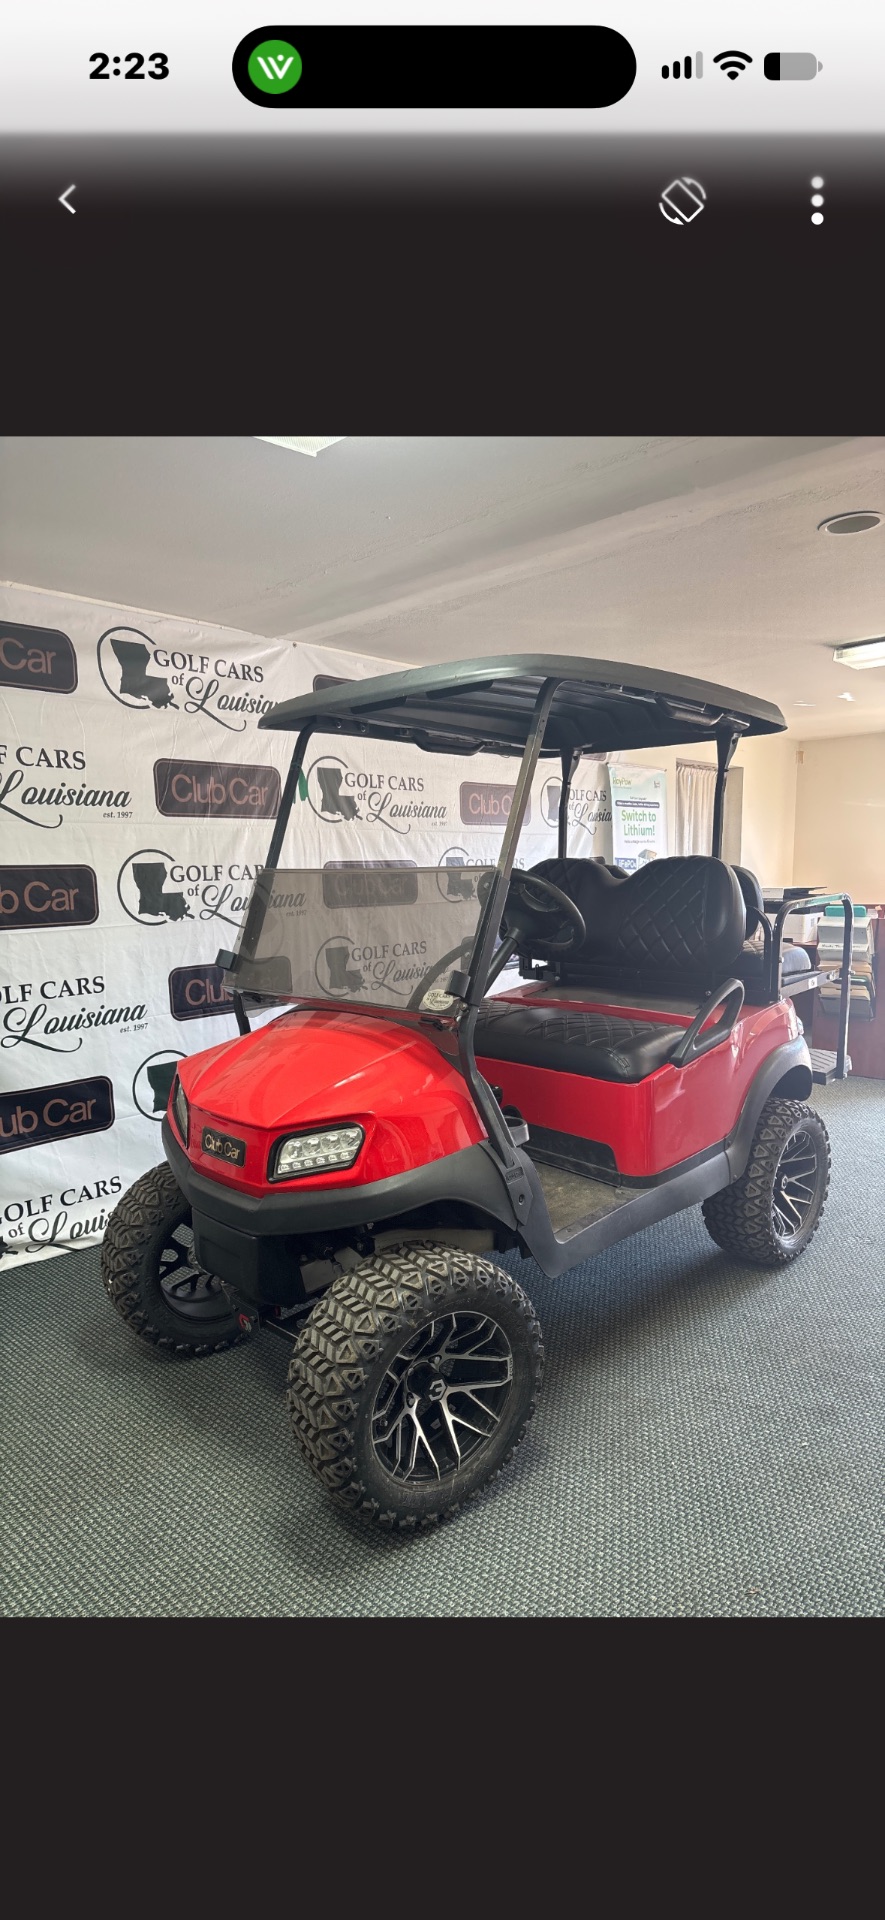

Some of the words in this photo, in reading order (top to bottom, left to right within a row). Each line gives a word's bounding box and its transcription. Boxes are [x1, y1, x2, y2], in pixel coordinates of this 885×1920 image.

[153, 650, 210, 674] GOLF
[214, 659, 264, 683] CARS
[171, 673, 185, 686] of
[184, 676, 279, 732] Louisia
[15, 746, 87, 771] CARS
[171, 773, 227, 805] Club
[229, 777, 269, 807] Car
[344, 772, 385, 790] GOLF
[387, 775, 425, 792] CARS
[117, 811, 134, 819] 1997
[357, 790, 367, 801] of
[366, 791, 447, 835] Louisiana
[469, 793, 500, 816] Club
[621, 809, 648, 822] Switch
[648, 811, 657, 822] to
[623, 823, 656, 836] Lithium!
[170, 865, 223, 883] GOLF
[23, 880, 80, 913] Car
[187, 884, 200, 896] of
[351, 944, 390, 962] GOLF
[392, 940, 427, 958] CARS
[362, 961, 371, 973] of
[0, 983, 33, 1005] LF
[40, 975, 105, 1000] CARS
[0, 1003, 149, 1053] Louisiana
[133, 1022, 149, 1032] 1997
[42, 1098, 97, 1127] Car
[205, 1134, 224, 1154] Club
[224, 1141, 241, 1160] Car
[60, 1175, 122, 1207] CARS
[8, 1222, 24, 1239] of
